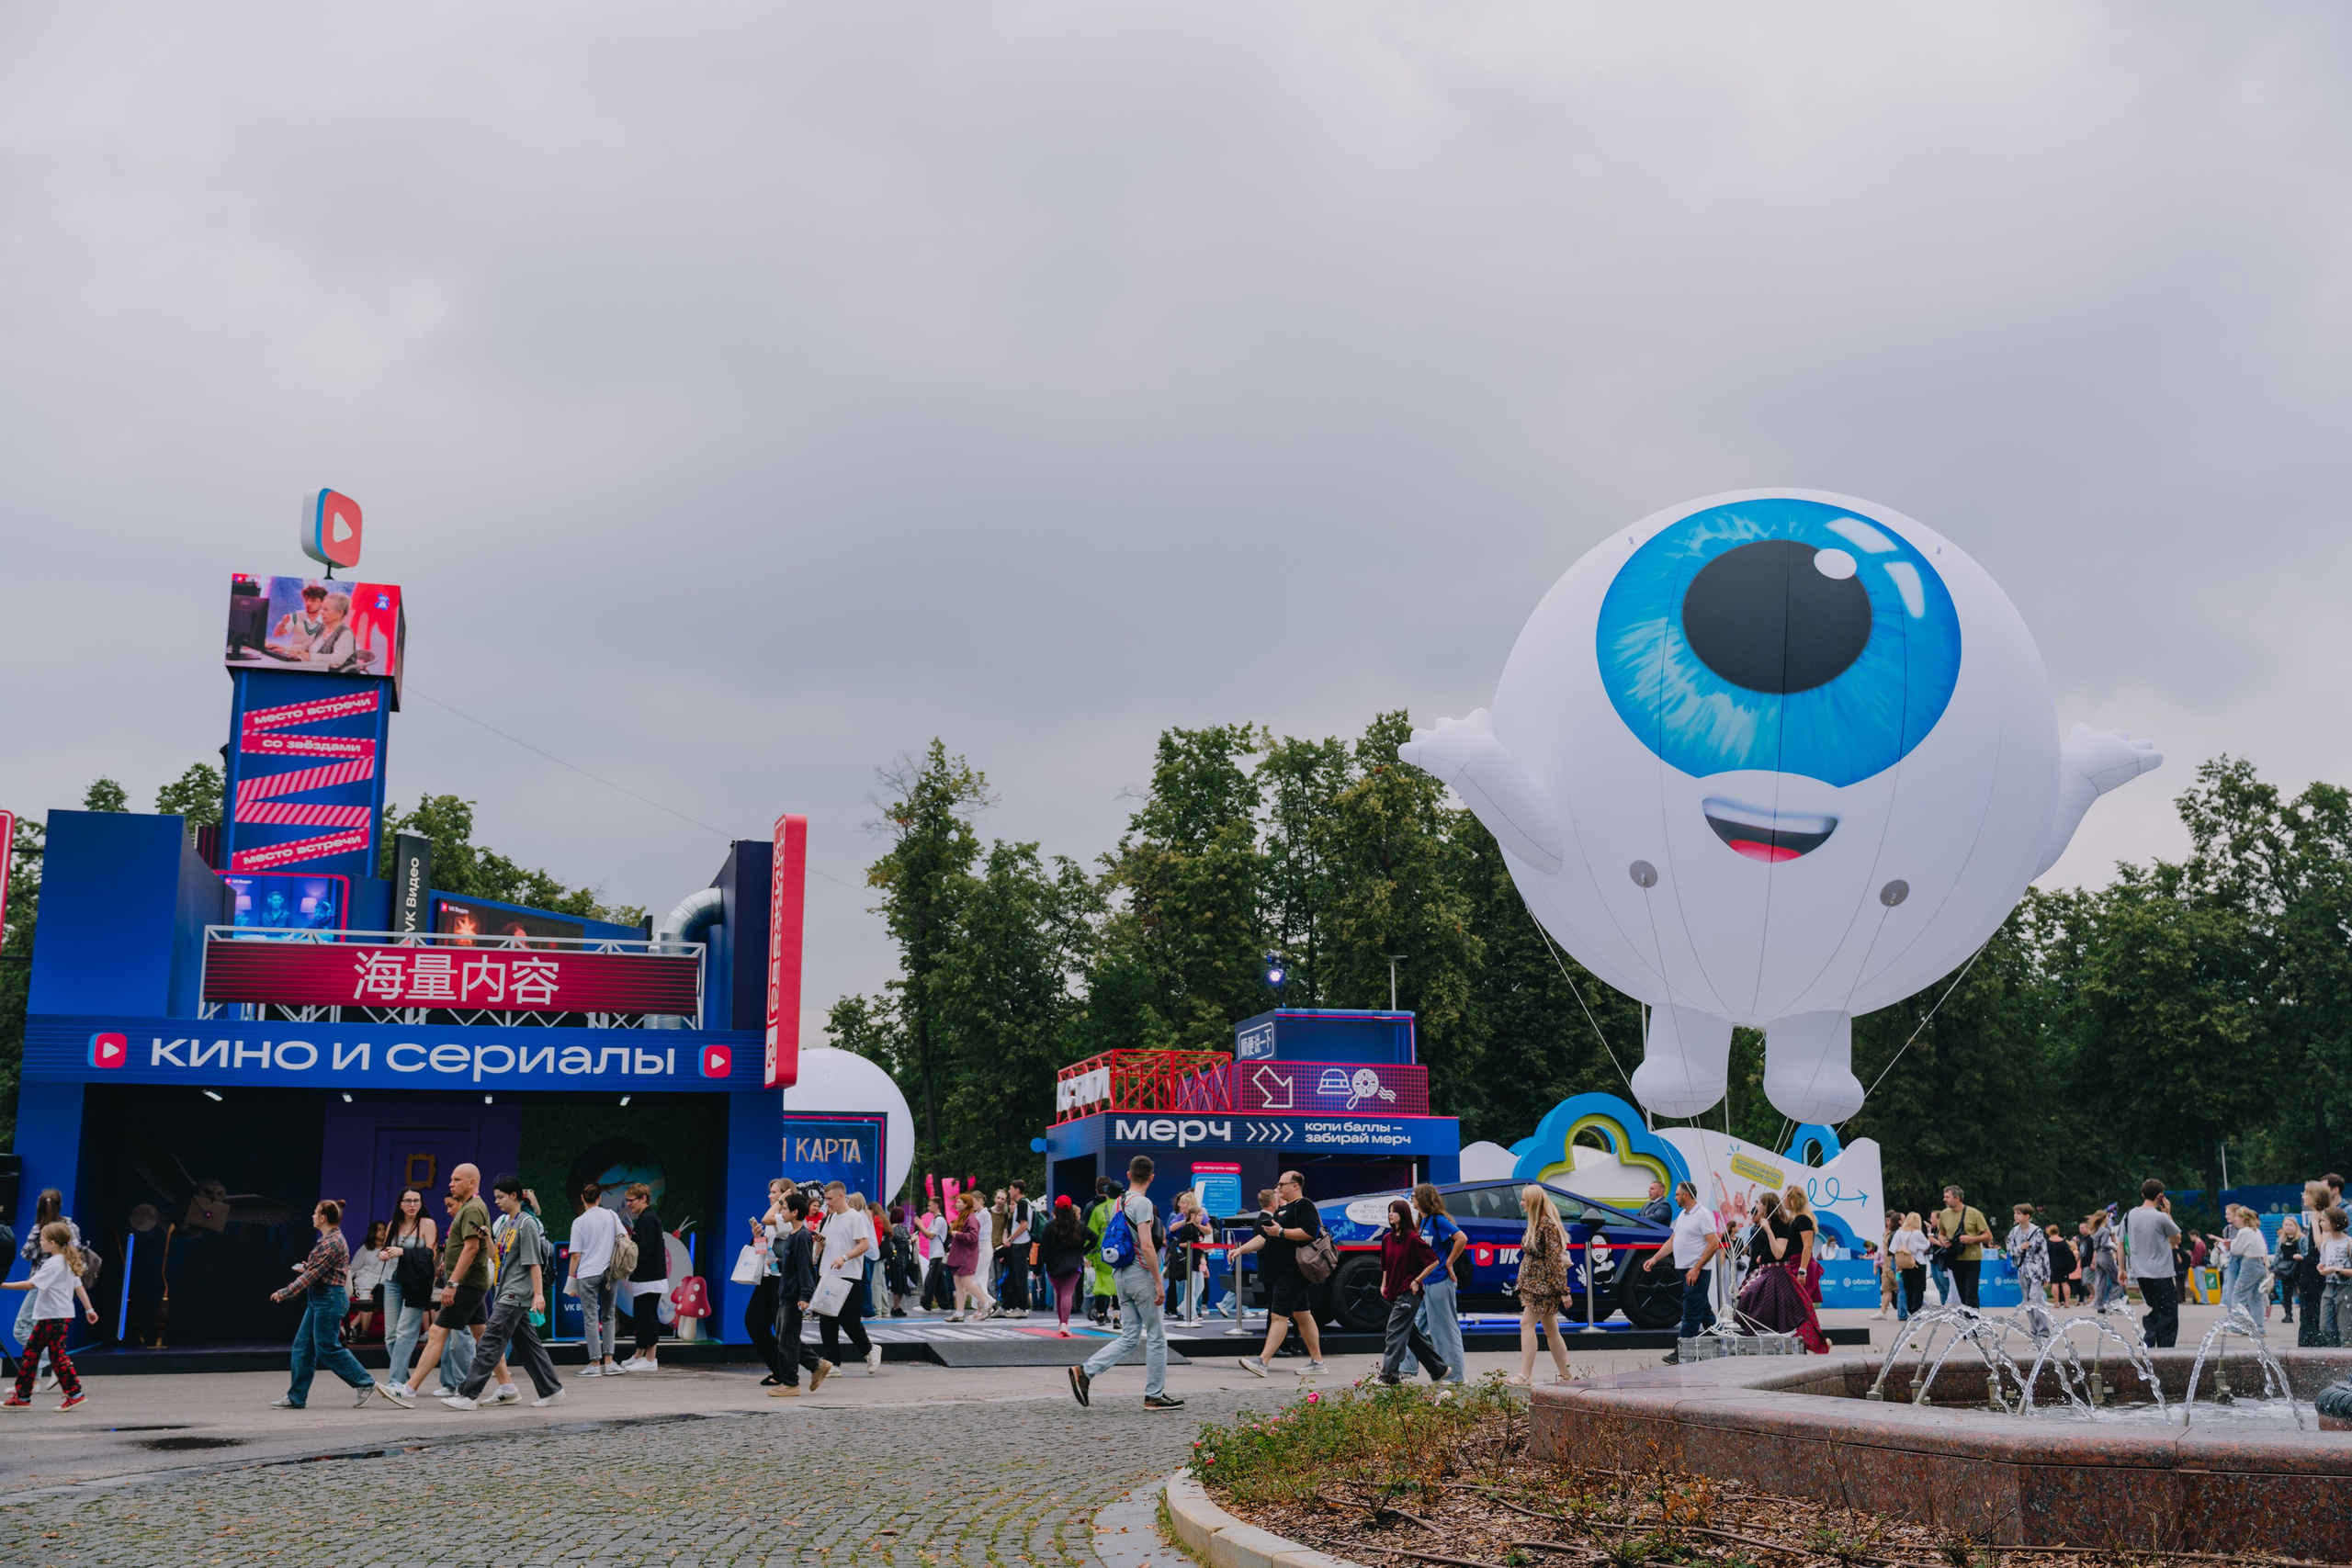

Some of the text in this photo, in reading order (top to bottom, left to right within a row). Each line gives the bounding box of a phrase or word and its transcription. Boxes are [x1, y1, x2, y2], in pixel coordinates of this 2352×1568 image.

[254, 697, 371, 725] место встречи
[262, 739, 362, 752] со звёздами
[243, 835, 362, 865] место встречи
[404, 857, 420, 932] VK Видео
[353, 950, 560, 1006] 海量内容
[151, 1038, 675, 1083] кино и сериалы
[1115, 1119, 1232, 1148] мерч
[1305, 1122, 1341, 1132] копи
[1343, 1122, 1391, 1133] баллы
[1305, 1133, 1411, 1146] забирай мерч
[796, 1137, 862, 1163] КАРТА
[1498, 1248, 1521, 1264] VK
